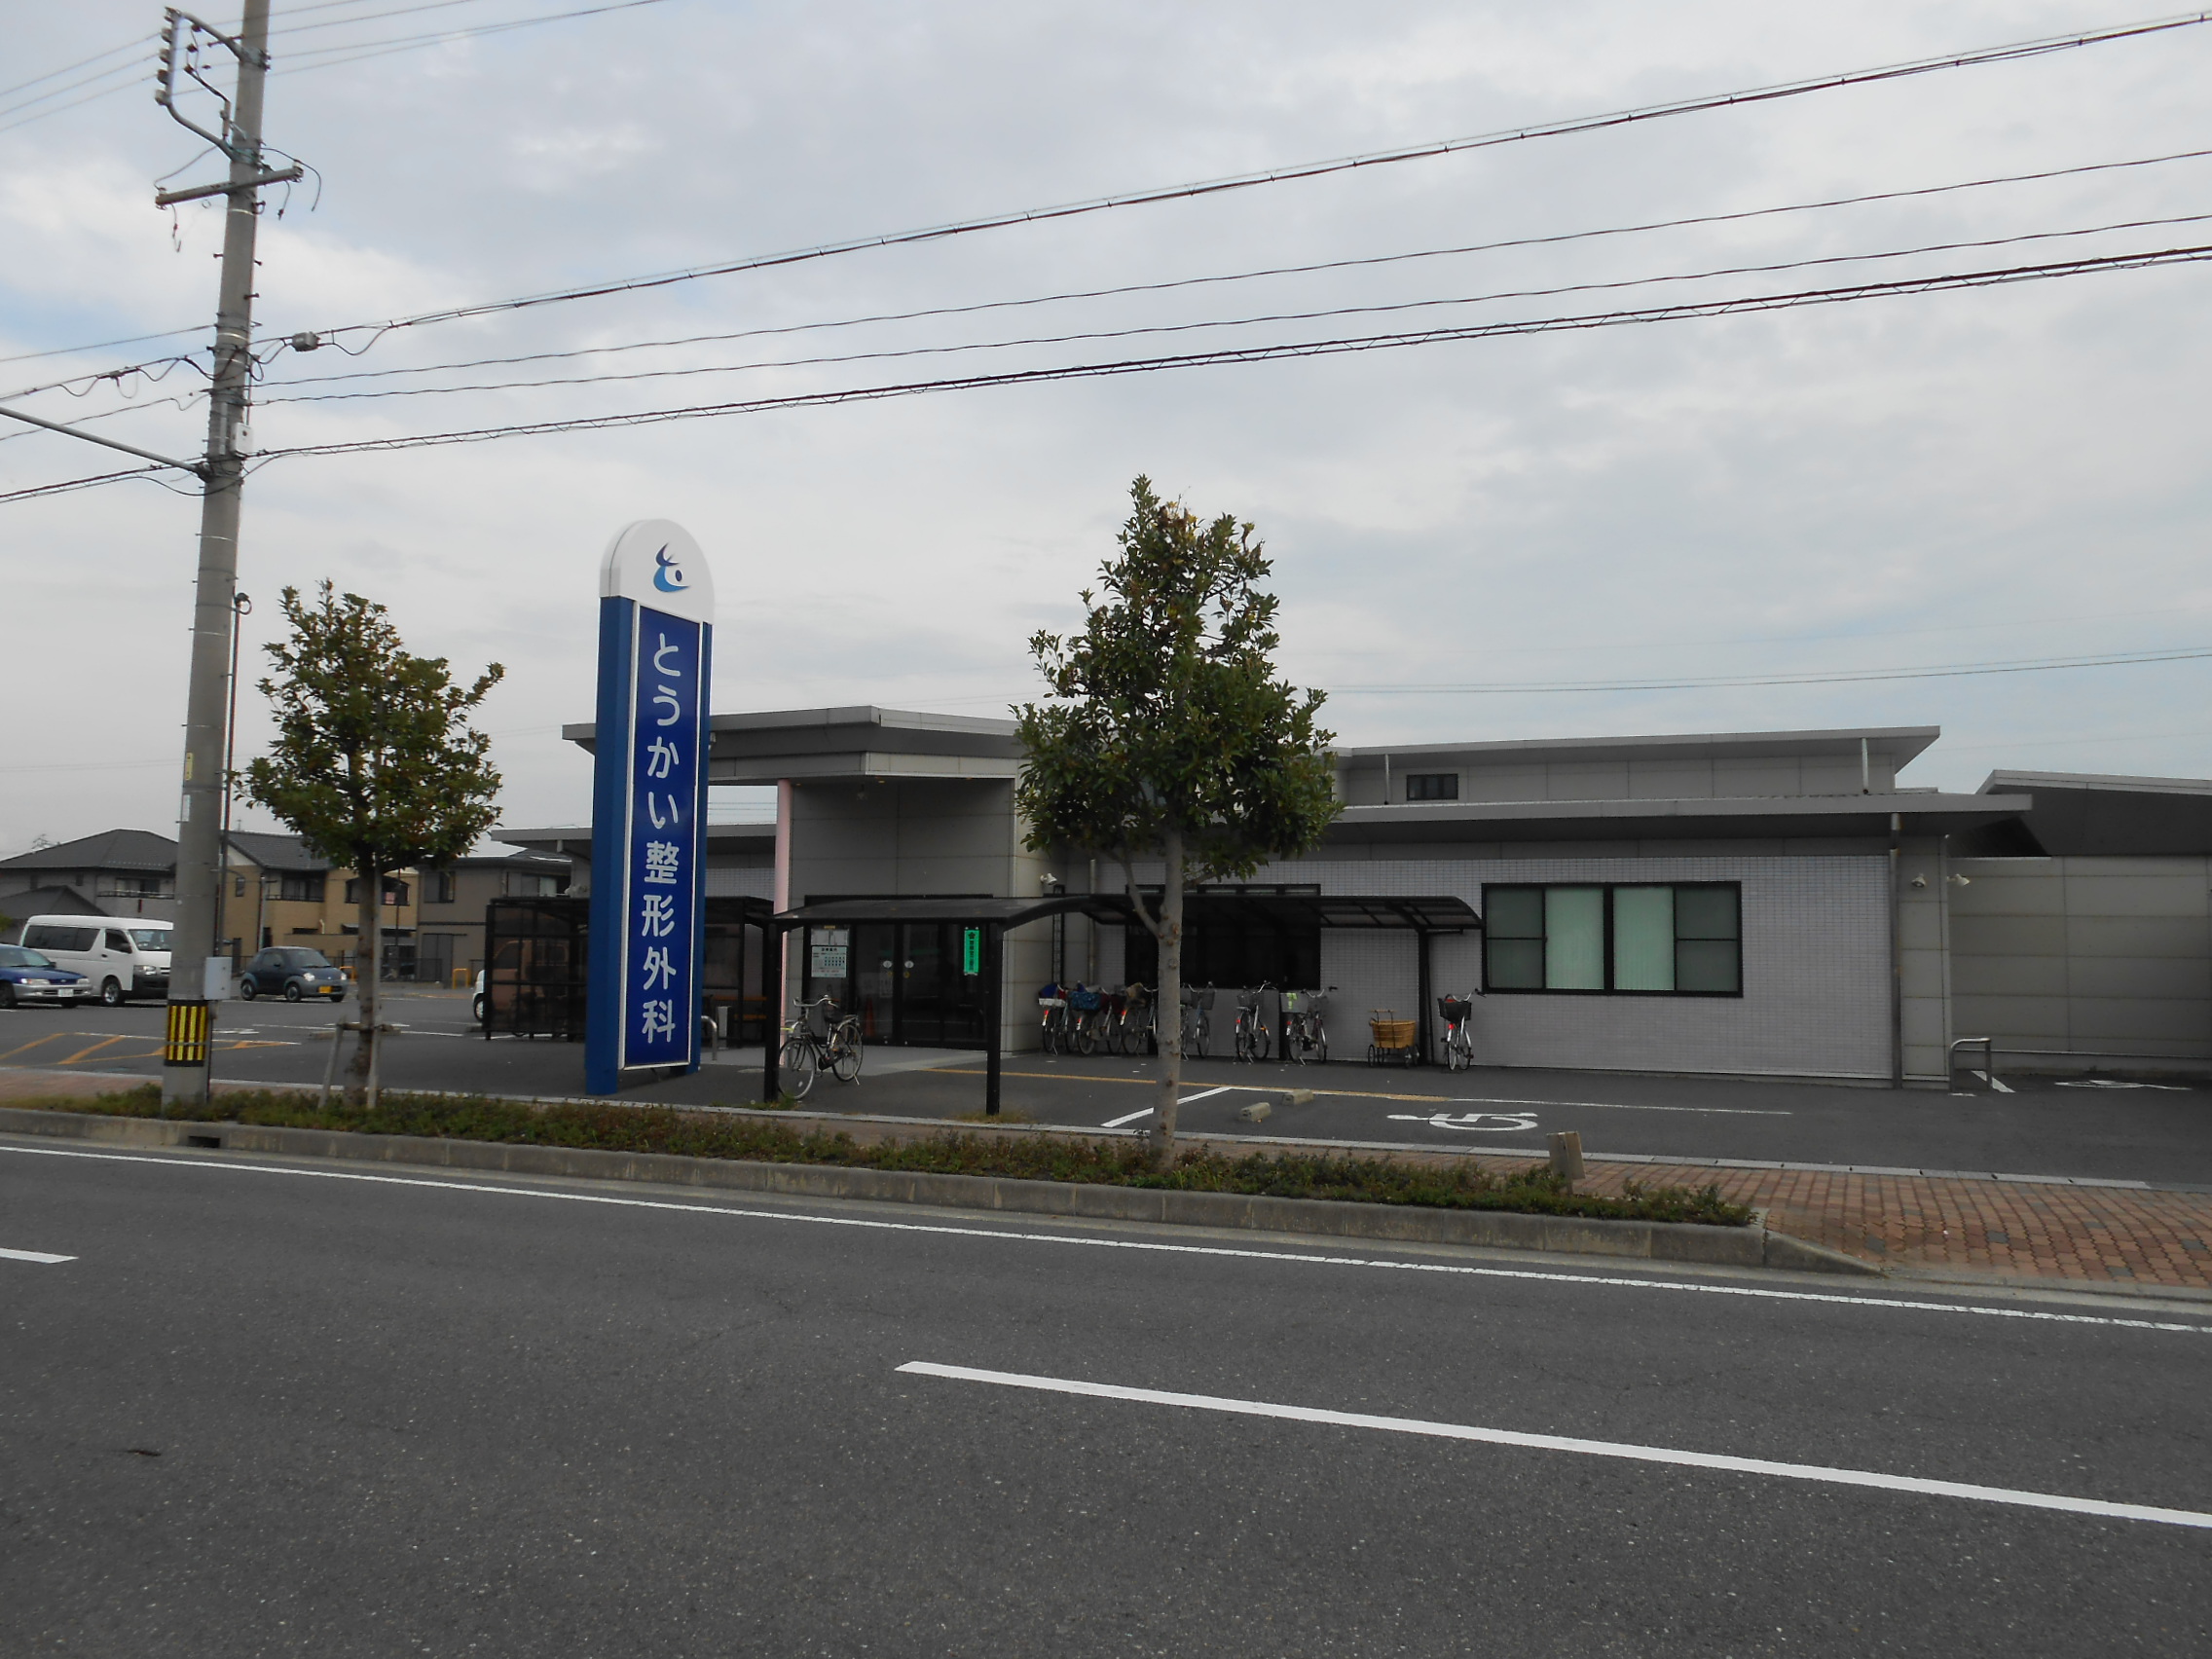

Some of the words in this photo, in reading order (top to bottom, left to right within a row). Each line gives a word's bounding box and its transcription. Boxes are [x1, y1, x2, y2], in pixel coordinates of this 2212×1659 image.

[642, 633, 681, 1044] とうかい整形外科
